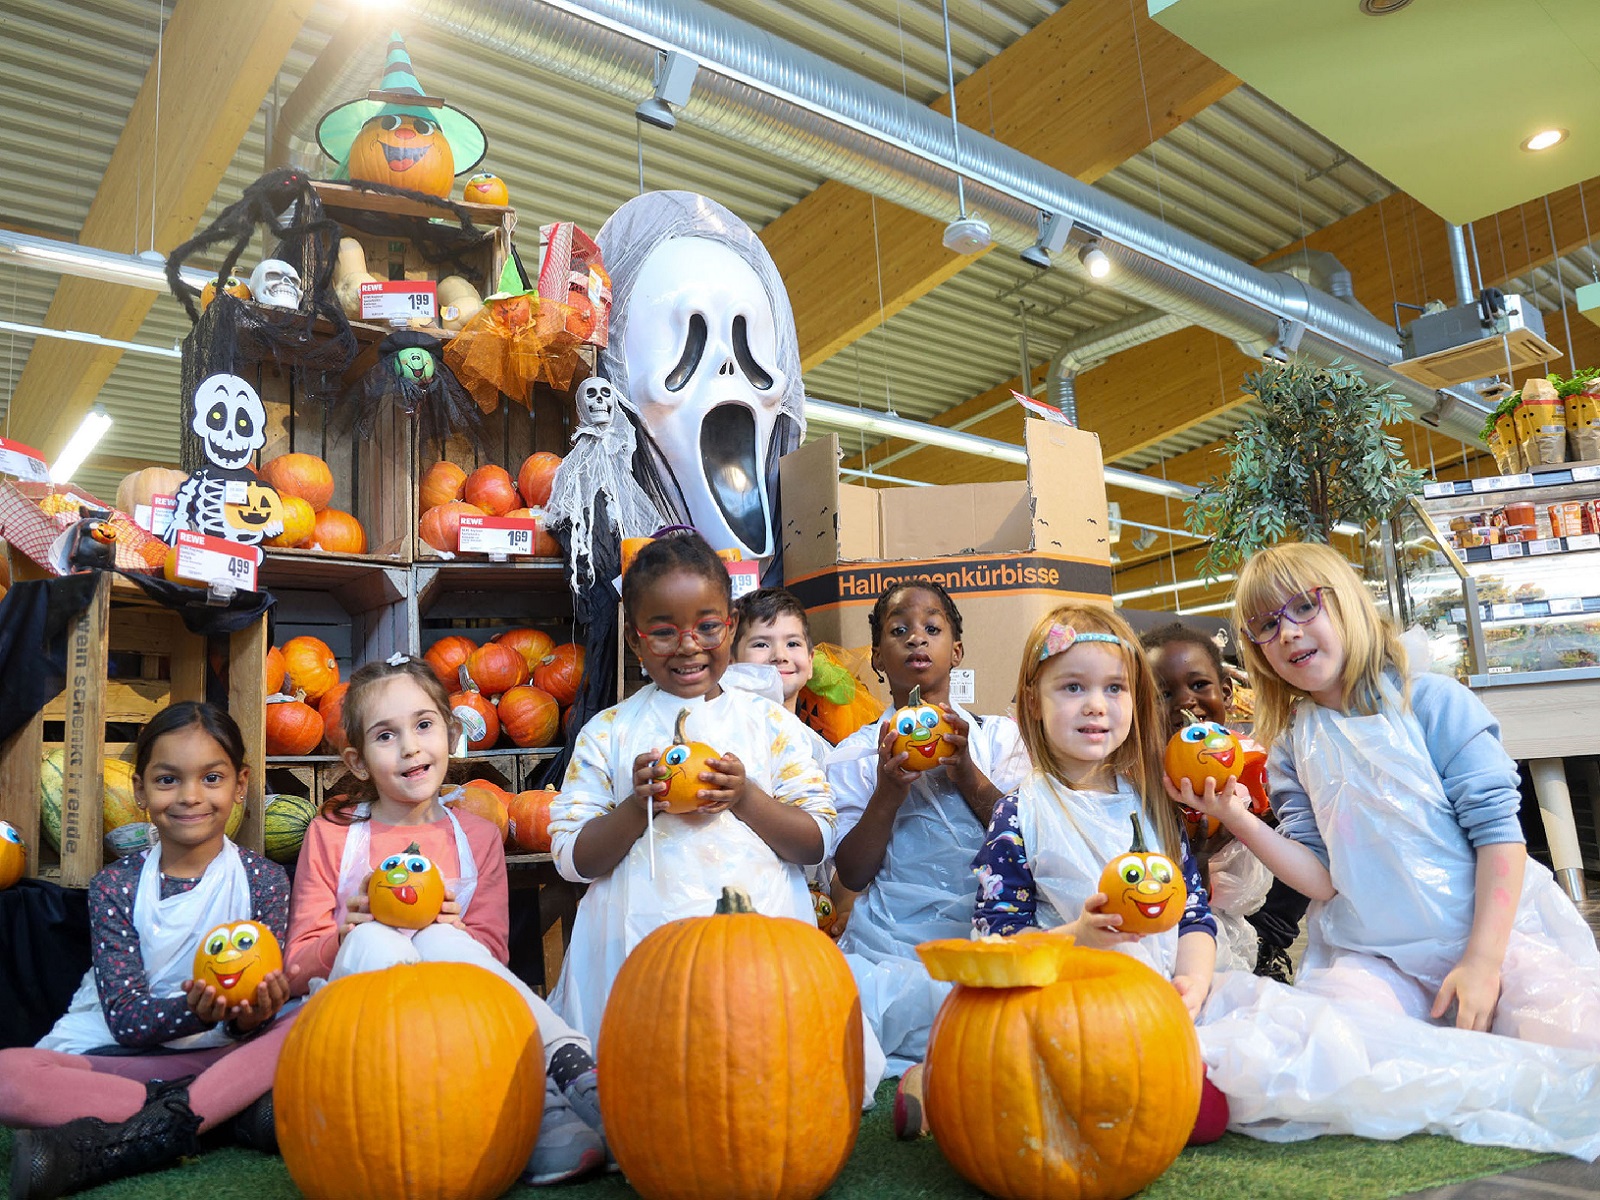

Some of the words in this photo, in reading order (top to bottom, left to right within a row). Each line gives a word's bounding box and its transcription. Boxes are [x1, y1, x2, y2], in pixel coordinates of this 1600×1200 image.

[361, 284, 383, 292] REWE
[460, 517, 483, 526] REWE
[179, 531, 205, 545] REWE
